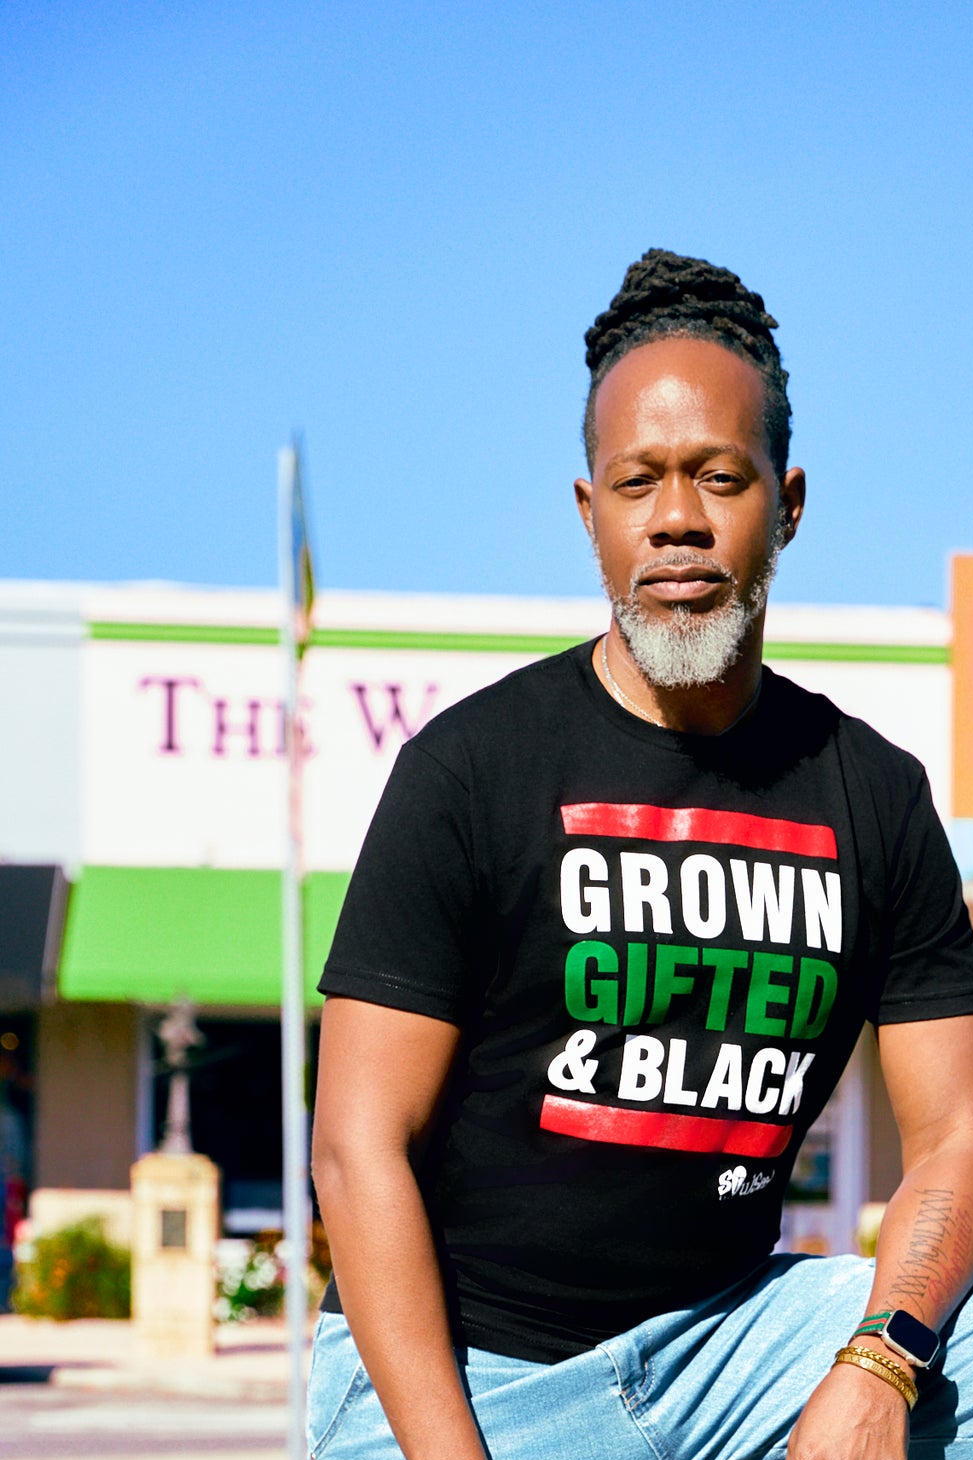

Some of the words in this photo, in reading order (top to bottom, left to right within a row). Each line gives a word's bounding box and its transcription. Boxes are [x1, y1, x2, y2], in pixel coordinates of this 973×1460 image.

[560, 847, 842, 953] GROWN
[564, 940, 839, 1040] GIFTED
[547, 1029, 599, 1094] &
[618, 1034, 816, 1116] BLACK
